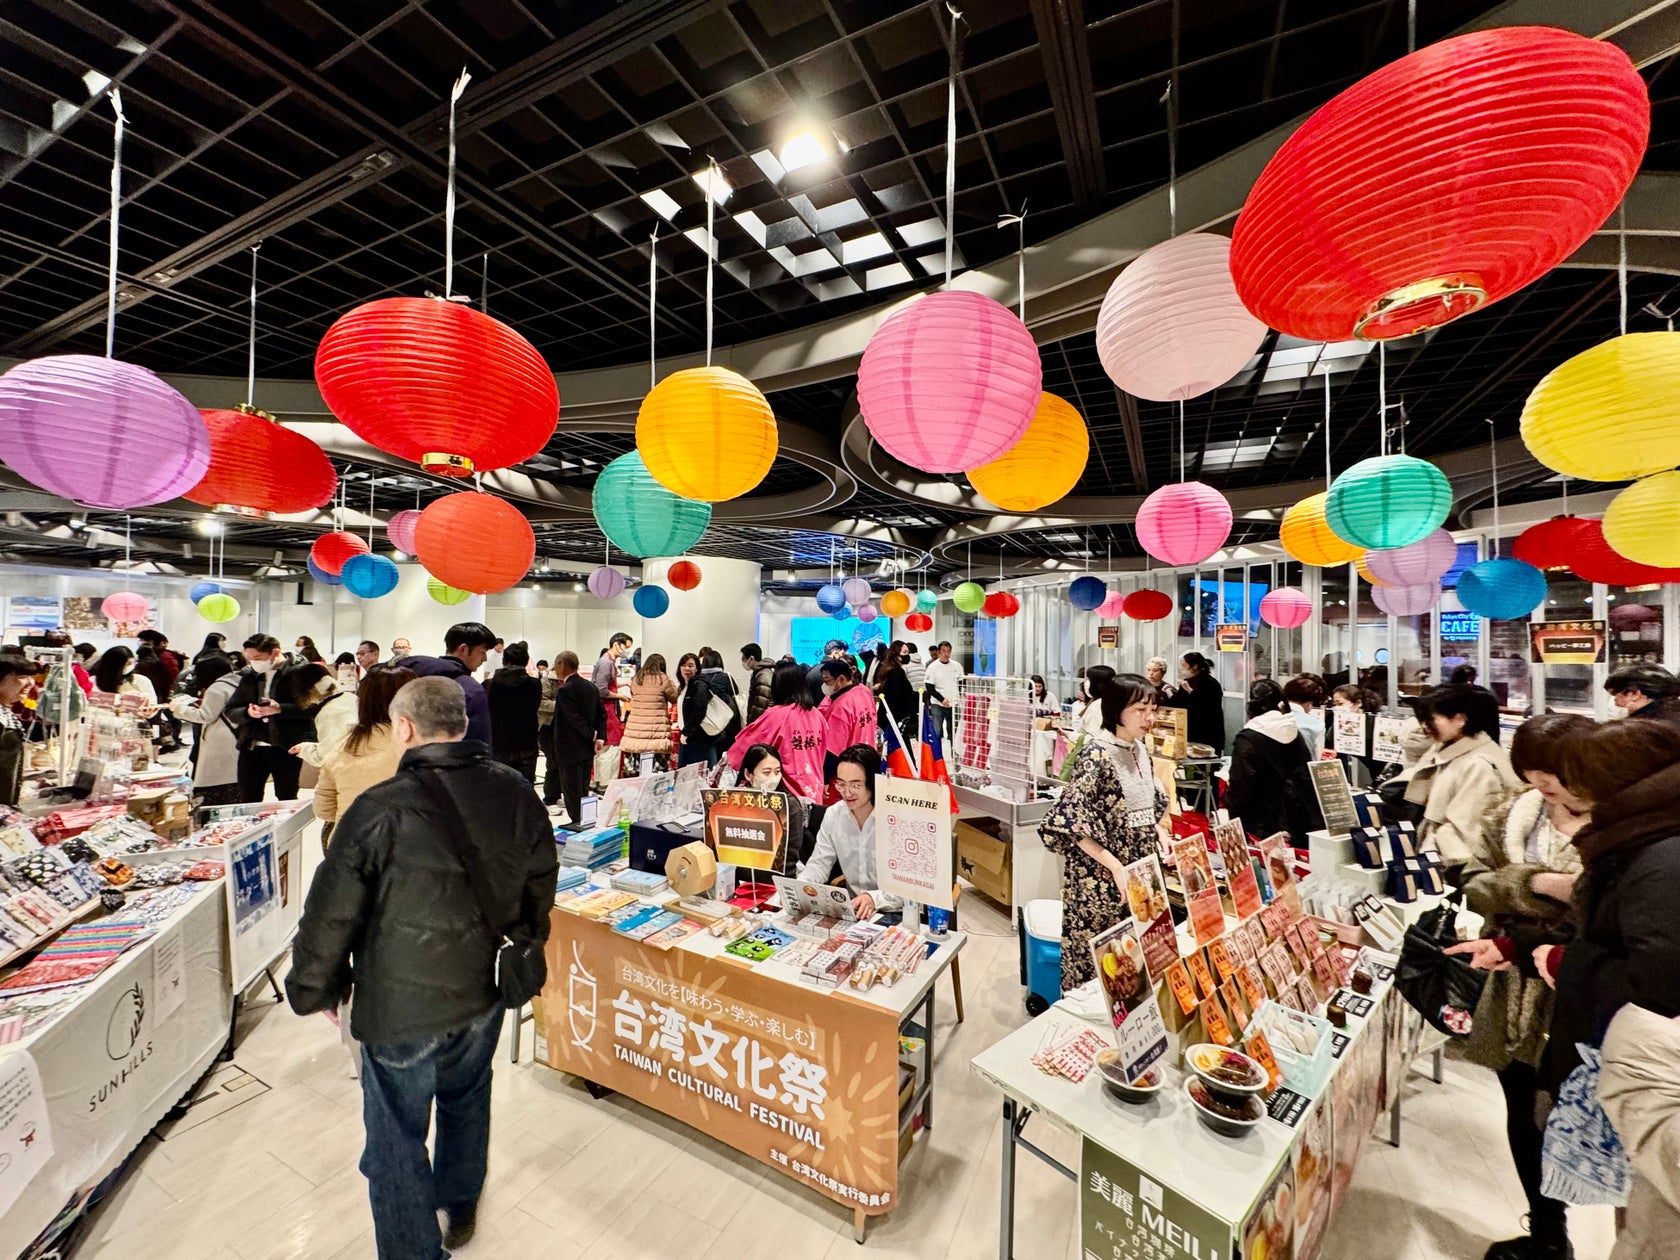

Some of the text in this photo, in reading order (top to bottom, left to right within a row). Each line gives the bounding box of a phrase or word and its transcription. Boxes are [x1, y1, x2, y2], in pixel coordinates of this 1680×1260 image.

[1441, 621, 1481, 632] CAFE
[718, 790, 784, 810] 台湾文化祭
[885, 794, 939, 810] SCAN HERE
[725, 826, 766, 841] 無料抽選会
[1119, 1002, 1159, 1045] ルーロー飯
[89, 1041, 153, 1112] SUNHILLS
[612, 989, 829, 1121] 台湾文化祭
[613, 1042, 826, 1151] TAIWAN CULTURAL FESTIVAL
[769, 1148, 891, 1207] 主催 台湾文化祭実行委員会
[1090, 1170, 1134, 1216] 美麗
